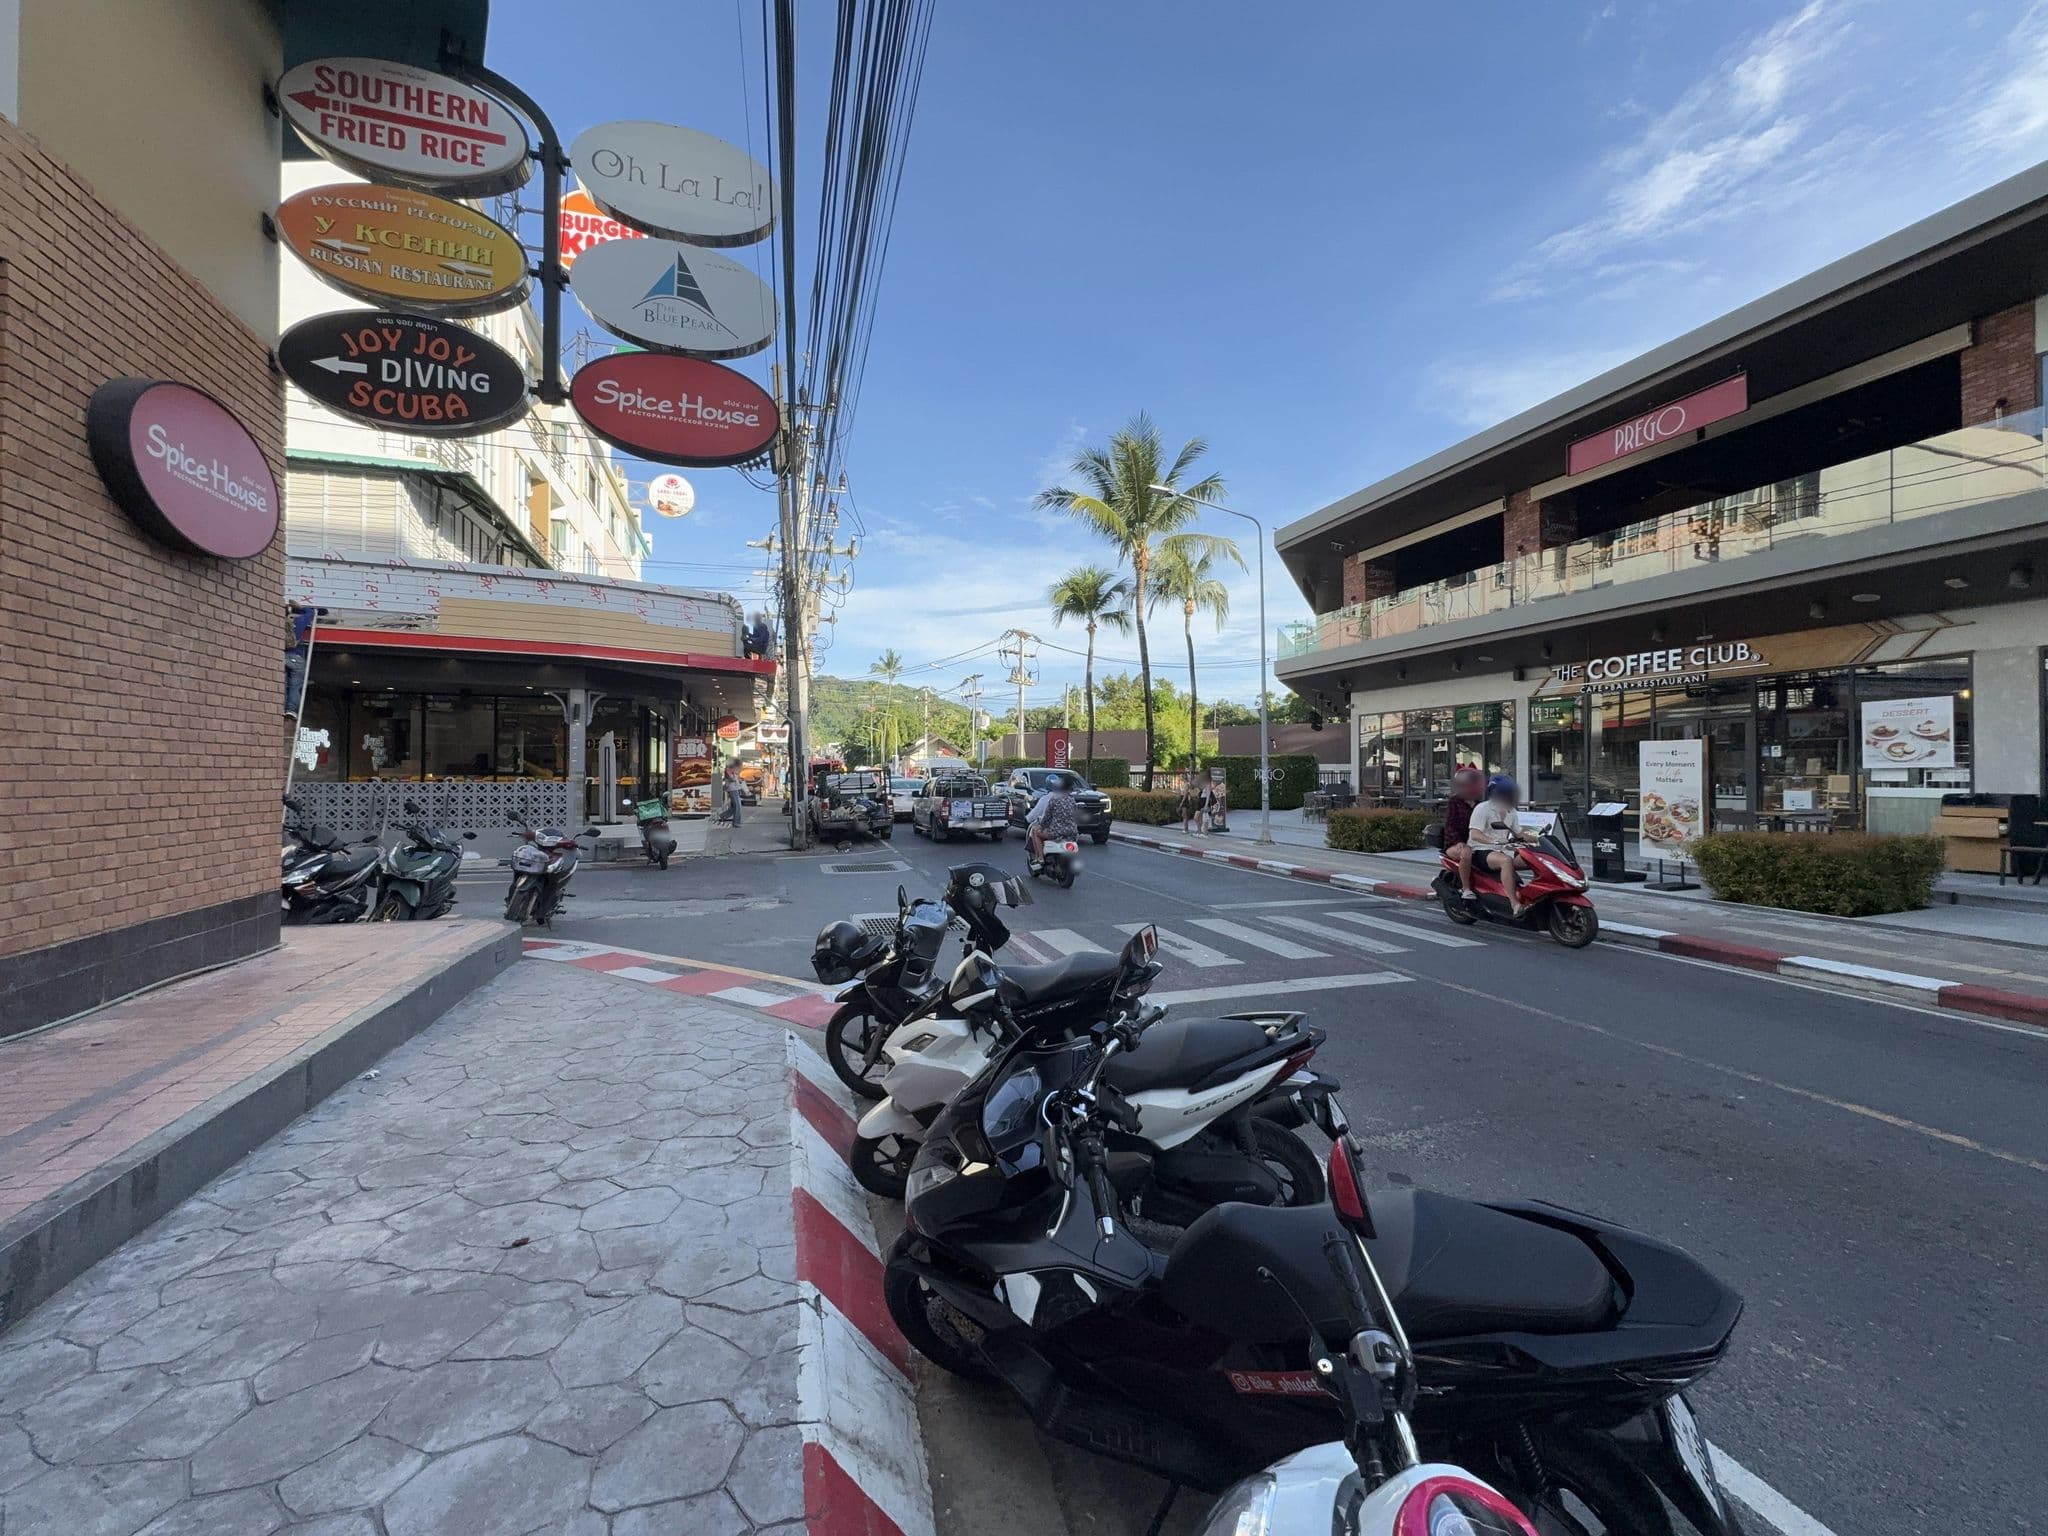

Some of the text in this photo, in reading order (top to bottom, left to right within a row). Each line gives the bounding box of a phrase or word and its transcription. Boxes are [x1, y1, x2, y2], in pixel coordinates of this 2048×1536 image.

[314, 65, 489, 127] SOUTHERN
[320, 113, 486, 167] FRIED RICE
[591, 149, 763, 211] Oh La La!
[310, 248, 495, 290] RUSSIAN RESTAURANT
[341, 328, 476, 368] JOY JOY
[381, 358, 490, 393] DIVING
[348, 380, 469, 420] SCUBA
[594, 380, 760, 427] Spice House
[1615, 406, 1686, 455] PREGO
[146, 424, 268, 513] Spice House
[1553, 642, 1750, 681] THE COFFEE CLUB
[1610, 681, 1628, 691] BAR
[1637, 674, 1706, 688] RESTAURANT
[1882, 708, 1931, 718] DESSERT
[677, 743, 708, 758] BBQ
[1055, 739, 1066, 768] PREGO
[1254, 768, 1285, 780] PRGO
